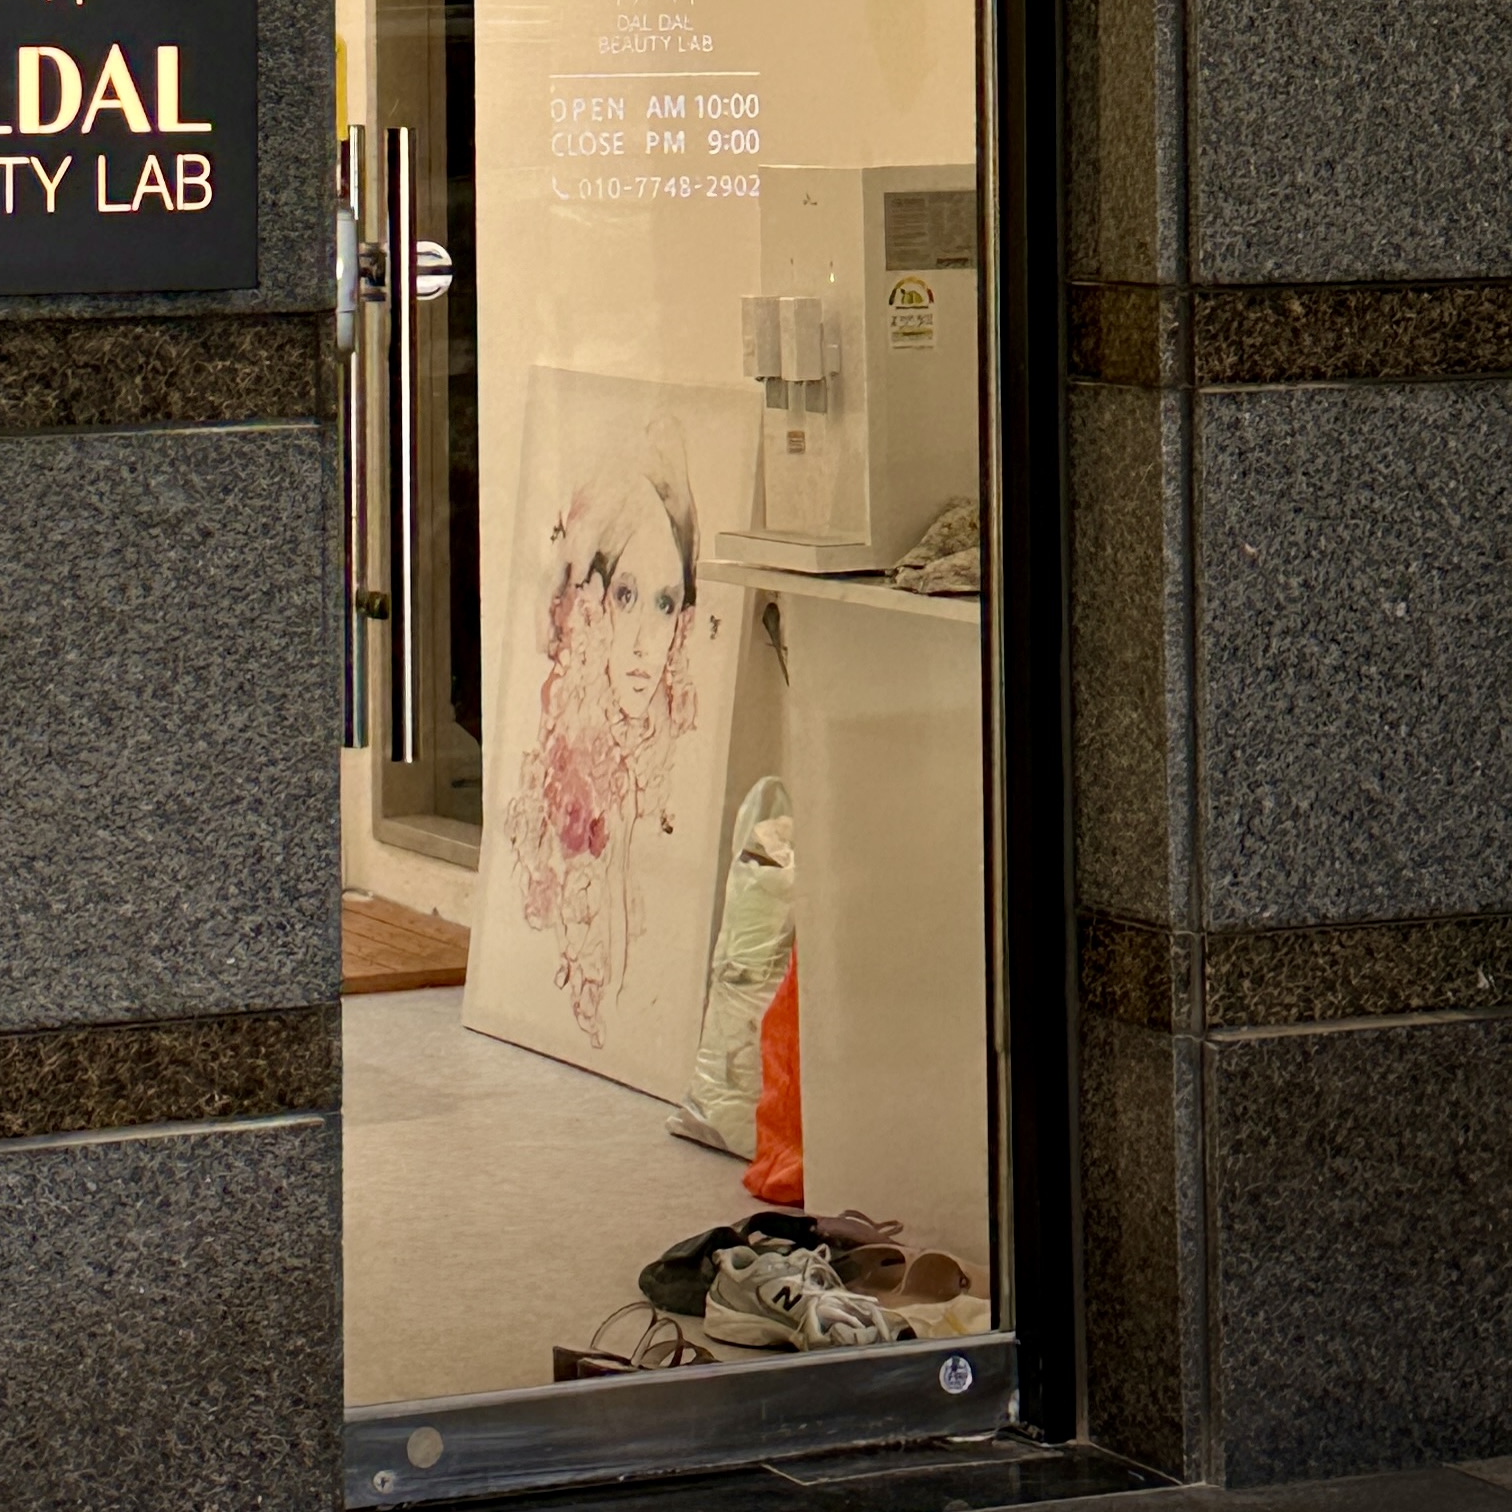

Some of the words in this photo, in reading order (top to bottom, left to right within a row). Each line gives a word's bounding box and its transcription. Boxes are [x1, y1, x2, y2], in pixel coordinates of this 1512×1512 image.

[616, 14, 652, 32] DAL
[658, 13, 694, 31] DAL
[599, 36, 672, 54] BEAUTY
[678, 35, 714, 52] LAB
[550, 97, 625, 123] OPEN
[646, 94, 686, 119] AM
[694, 93, 760, 119] 10:00
[551, 132, 625, 157] CLOSE
[645, 131, 686, 155] PM
[708, 129, 760, 155] 9:00
[97, 153, 214, 213] LAB
[578, 174, 761, 201] 010-7748-2902
